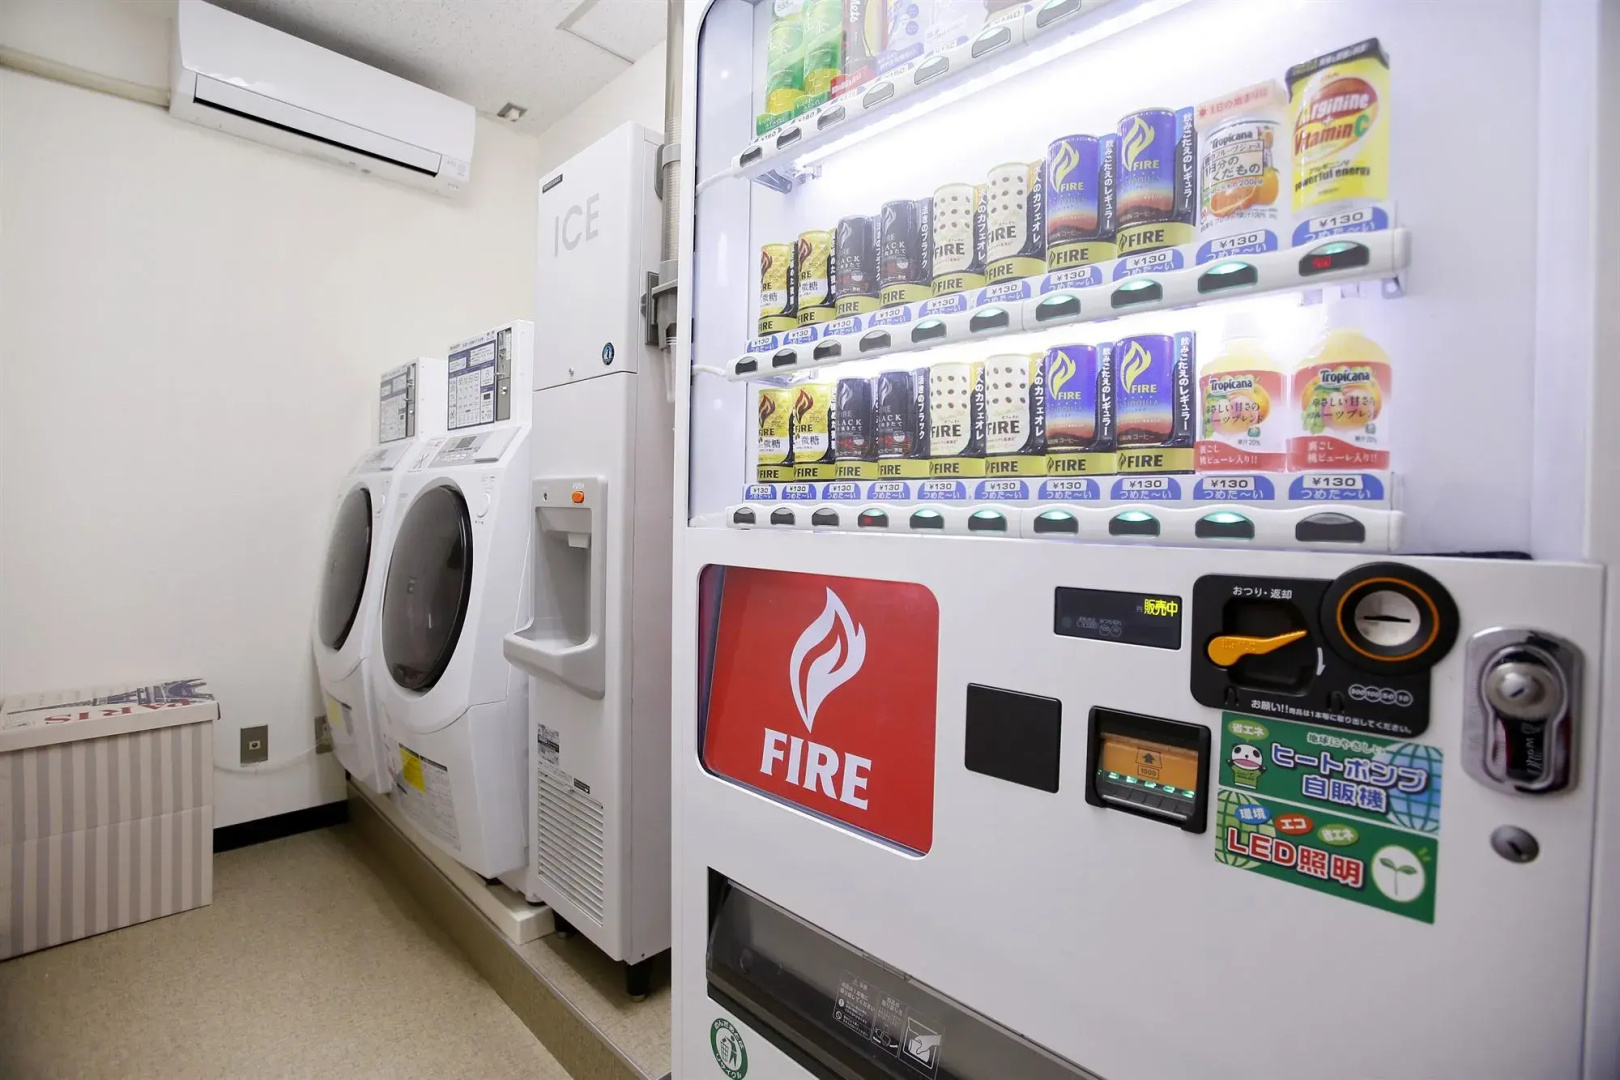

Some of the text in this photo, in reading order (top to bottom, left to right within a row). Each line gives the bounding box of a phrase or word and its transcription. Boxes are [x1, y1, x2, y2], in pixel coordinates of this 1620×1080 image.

[1211, 131, 1253, 149] Tropicana
[1133, 159, 1160, 171] FIRE
[1213, 163, 1260, 182] くだもの
[1060, 181, 1085, 192] FIRE
[553, 193, 600, 258] ICE
[1319, 212, 1364, 228] ¥130
[988, 225, 1017, 245] FIRE
[1128, 229, 1165, 248] FIRE
[1219, 234, 1258, 249] ¥130
[934, 242, 965, 260] FIRE
[1056, 248, 1089, 265] FIRE
[1133, 253, 1167, 266] ¥130
[988, 263, 1014, 281] FIRE
[1056, 270, 1086, 281] ¥130
[937, 278, 963, 293] FIRE
[991, 284, 1018, 295] ¥130
[882, 289, 906, 304] FIRE
[931, 298, 955, 308] ¥130
[838, 301, 859, 314] FIRE
[880, 309, 900, 318] ¥130
[797, 312, 815, 325] FIRE
[833, 320, 851, 328] ¥130
[792, 330, 808, 338] ¥130
[754, 337, 770, 346] ¥130
[1320, 370, 1370, 383] Tropicana
[1131, 384, 1157, 394] FIRE
[1178, 336, 1190, 431] 飲みごたえのレギュラー
[1210, 379, 1253, 391] Tropicana
[1034, 358, 1044, 437] 大人のカフェオレ
[1058, 391, 1082, 400] FIRE
[795, 424, 813, 433] FIRE
[931, 424, 962, 438] FIRE
[987, 420, 1020, 436] FIRE
[763, 438, 781, 449] 微糖
[801, 435, 819, 446] 微糖
[990, 460, 1019, 473] FIRE
[1055, 459, 1086, 472] FIRE
[1127, 454, 1163, 468] FIRE
[759, 469, 779, 479] FIRE
[796, 467, 818, 478] FIRE
[838, 466, 861, 477] FIRE
[880, 464, 901, 475] FIRE
[934, 462, 960, 474] FIRE
[990, 482, 1016, 490] ¥130
[1052, 482, 1082, 490] ¥130
[1129, 479, 1162, 488] ¥130
[1210, 479, 1248, 489] ¥130
[1312, 477, 1356, 487] ¥130
[1232, 586, 1293, 600] おつり・返却
[1144, 598, 1179, 617] 販売中
[1367, 690, 1380, 698] 100
[1231, 722, 1265, 737] 省エネ
[1307, 731, 1385, 755] 地球にやさしい
[759, 727, 872, 811] FIRE
[1140, 768, 1157, 777] 1000
[1271, 743, 1428, 793] ヒートポンプ
[1302, 774, 1388, 813] 自販機
[1239, 807, 1267, 820] 環境
[1281, 817, 1307, 830] エコ
[1321, 828, 1355, 842] 省エネ
[1226, 827, 1364, 888] LED照明
